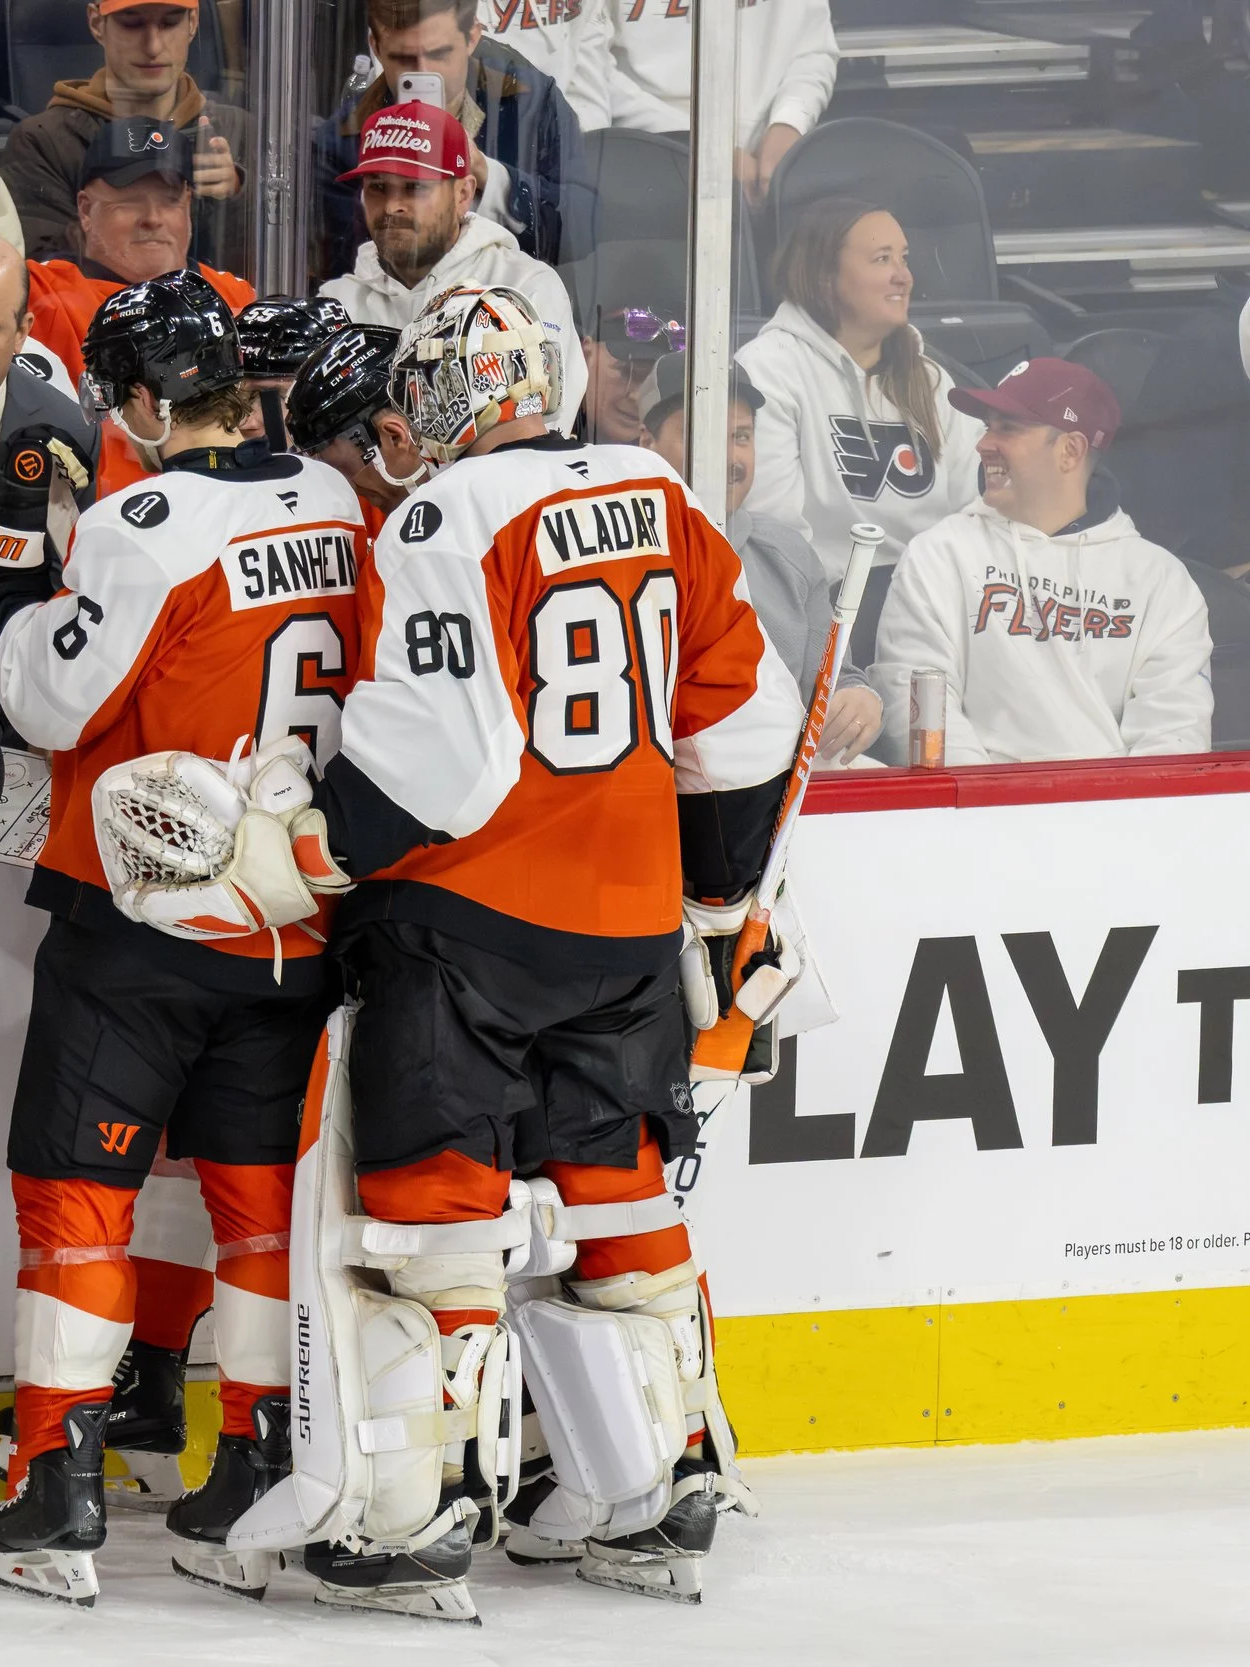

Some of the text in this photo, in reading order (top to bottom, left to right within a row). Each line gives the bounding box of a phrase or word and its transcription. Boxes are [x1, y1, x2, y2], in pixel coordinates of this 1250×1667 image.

[494, 0, 582, 34] YERS
[362, 128, 431, 155] Phillies
[102, 306, 147, 325] CHEVROLET
[207, 312, 224, 337] 6
[243, 307, 279, 321] 55
[330, 347, 379, 387] CHEVROLET
[128, 494, 161, 523] 1
[409, 505, 425, 538] 1
[541, 497, 661, 562] VLADAR
[986, 565, 1109, 609] PHILDELPHIA
[53, 595, 104, 661] 6
[974, 583, 1136, 642] FLYERS
[405, 610, 476, 680] 80
[527, 568, 679, 777] 80
[255, 611, 348, 782] 6
[748, 925, 1161, 1166] LAY
[1065, 1243, 1111, 1260] Players
[1114, 1239, 1146, 1254] must
[1150, 1238, 1166, 1252] be
[1169, 1236, 1183, 1250] 18
[1187, 1238, 1201, 1250] or
[1203, 1233, 1240, 1249] older.
[297, 1303, 311, 1445] SUPREME
